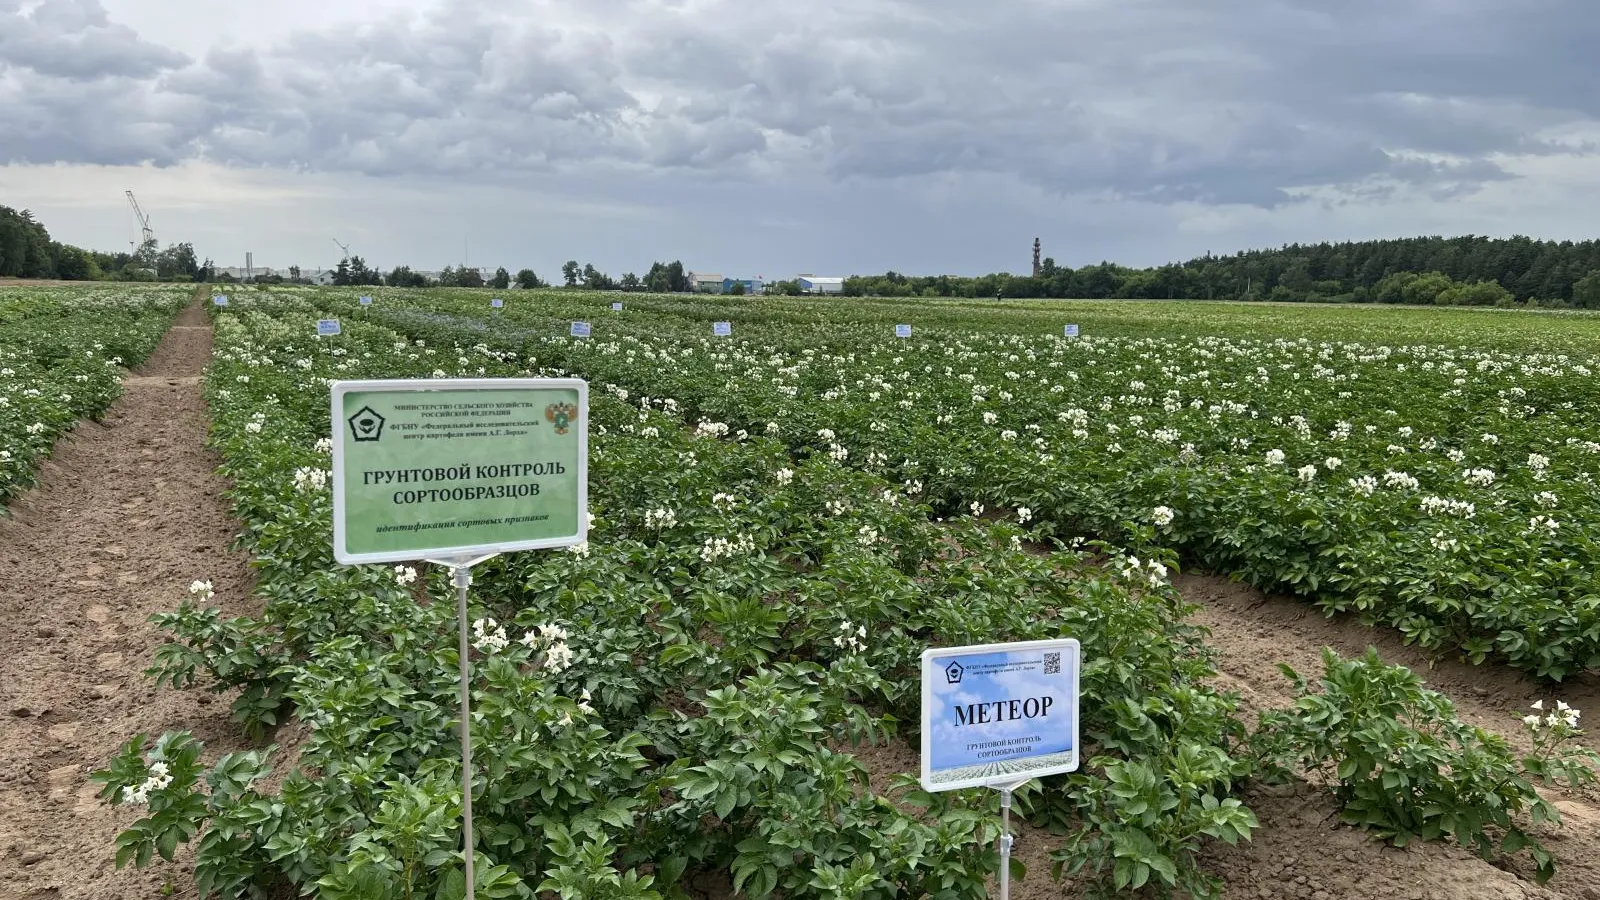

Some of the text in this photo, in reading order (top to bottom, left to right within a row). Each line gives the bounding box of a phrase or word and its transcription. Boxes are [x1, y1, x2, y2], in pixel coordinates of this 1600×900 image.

[363, 461, 565, 485] ГРУНТОВОЙ КОНТРОЛЬ
[393, 483, 540, 505] СОРТООБРАЗЦОВ
[376, 513, 549, 534] идентификация сортовых признаков
[953, 696, 1053, 727] МЕТЕОР
[966, 735, 1042, 751] ГРУНТОВОЙ КОНТРОЛЬ
[977, 746, 1032, 759] СОРТООБРАЗЦОВ
